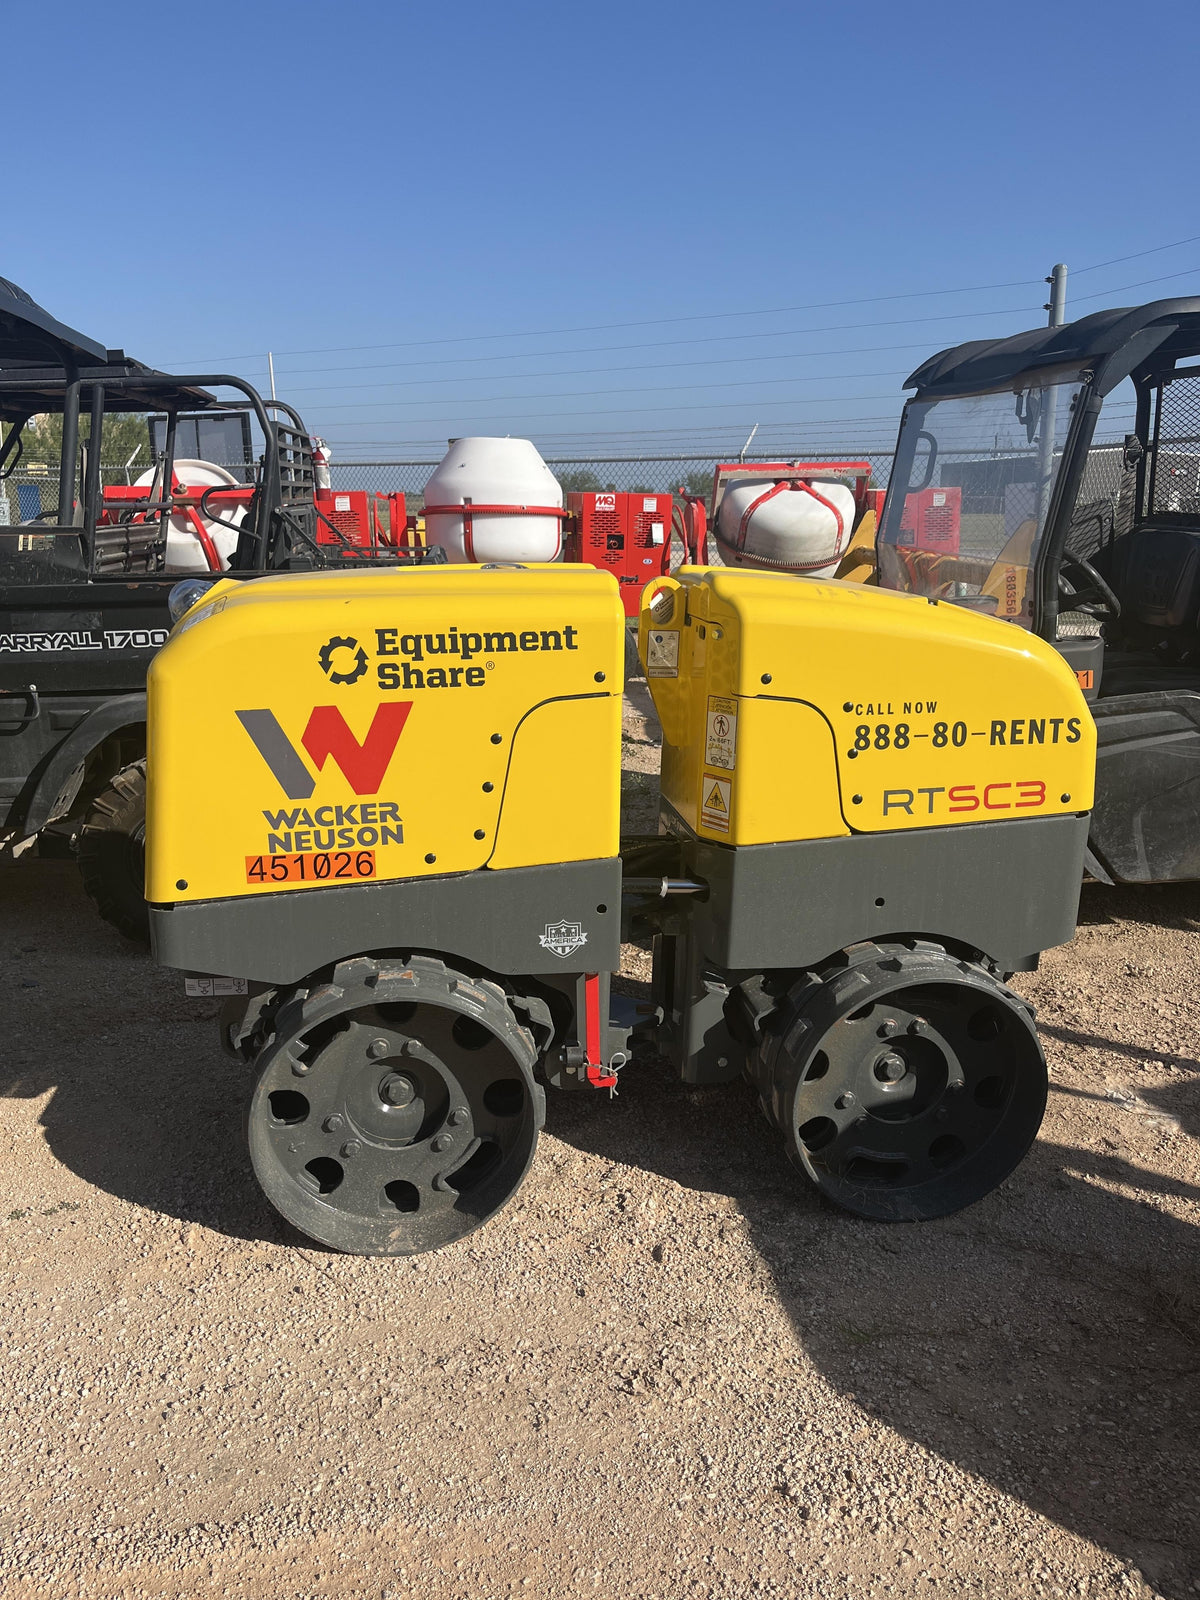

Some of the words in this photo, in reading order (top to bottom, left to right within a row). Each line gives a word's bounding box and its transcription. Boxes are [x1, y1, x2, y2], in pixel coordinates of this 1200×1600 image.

[104, 629, 169, 648] 1700
[375, 625, 578, 661] Equipment
[855, 703, 894, 716] CALL
[903, 701, 938, 714] NOW
[854, 717, 1082, 751] 888-80-RENTS
[882, 780, 1046, 816] RTSC3
[262, 802, 403, 830] WACKER
[267, 824, 404, 854] NEUSON
[248, 851, 374, 882] 451026
[544, 936, 583, 945] AMERICA
